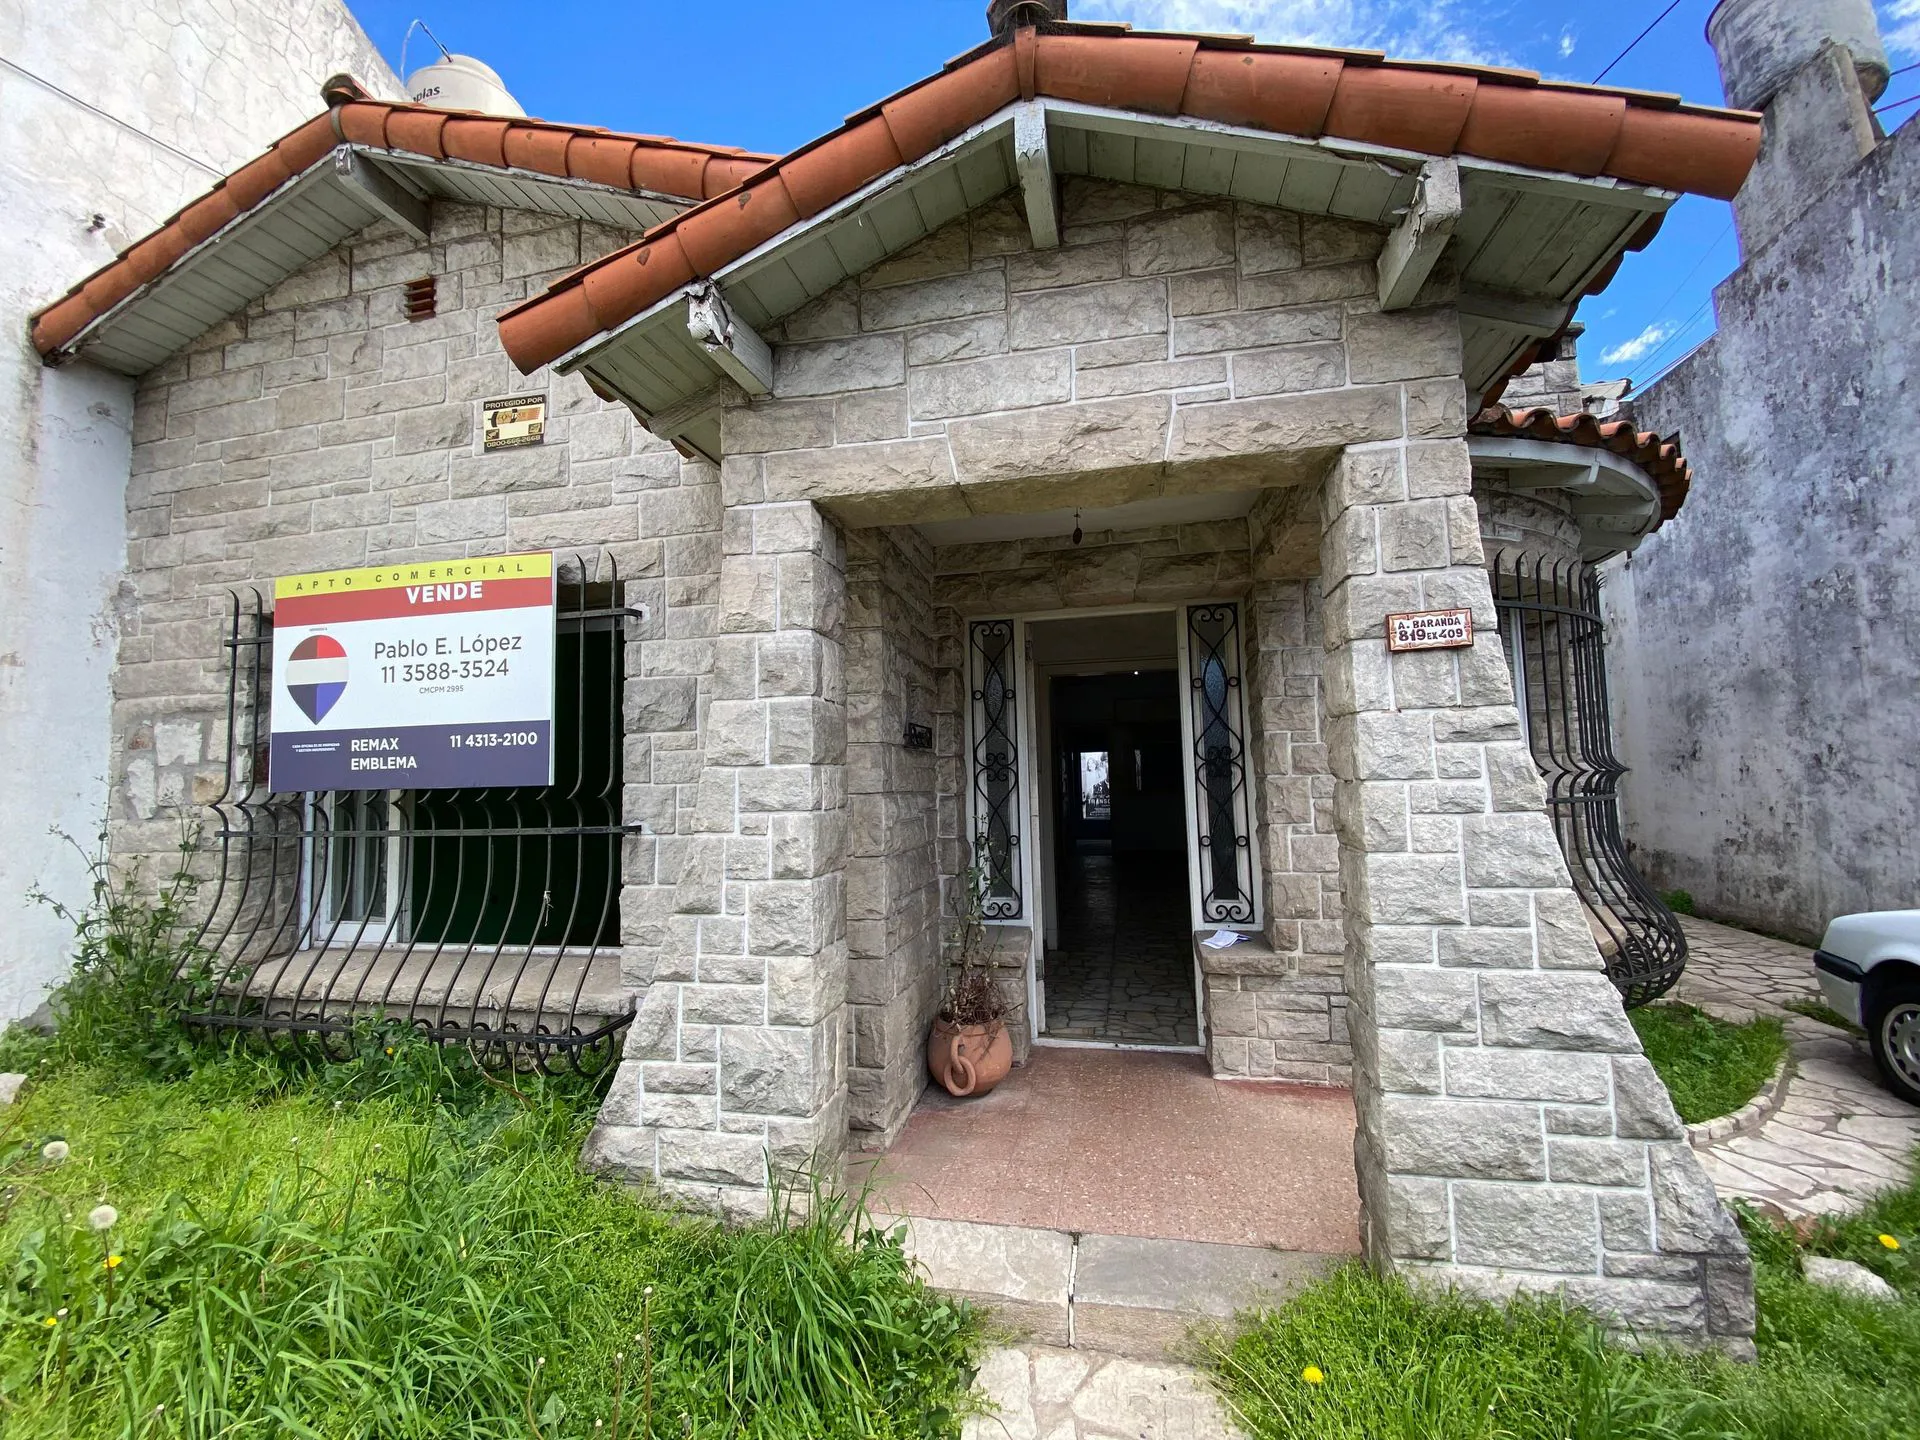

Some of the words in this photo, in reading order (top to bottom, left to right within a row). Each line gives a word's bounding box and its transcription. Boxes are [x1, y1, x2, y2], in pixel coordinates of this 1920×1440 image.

[485, 398, 526, 410] PROTEGIDO
[528, 396, 543, 404] POR
[296, 577, 352, 591] APTO
[375, 563, 523, 583] COMERCIAL
[406, 581, 483, 604] VENDE
[1398, 621, 1410, 630] A.
[1412, 617, 1461, 629] BARANDA
[1399, 628, 1426, 641] 819
[1427, 632, 1438, 640] EX
[1439, 628, 1463, 639] 409
[374, 639, 428, 659] Pablo
[435, 637, 452, 655] E.
[460, 634, 522, 658] López
[381, 665, 395, 684] 11
[402, 658, 509, 682] 3588-3524
[419, 686, 445, 695] CMCPM
[446, 684, 464, 693] 2995
[351, 737, 400, 752] REMAX
[450, 734, 461, 748] 11
[465, 732, 538, 747] 4313-2100
[351, 756, 417, 771] EMBLEMA
